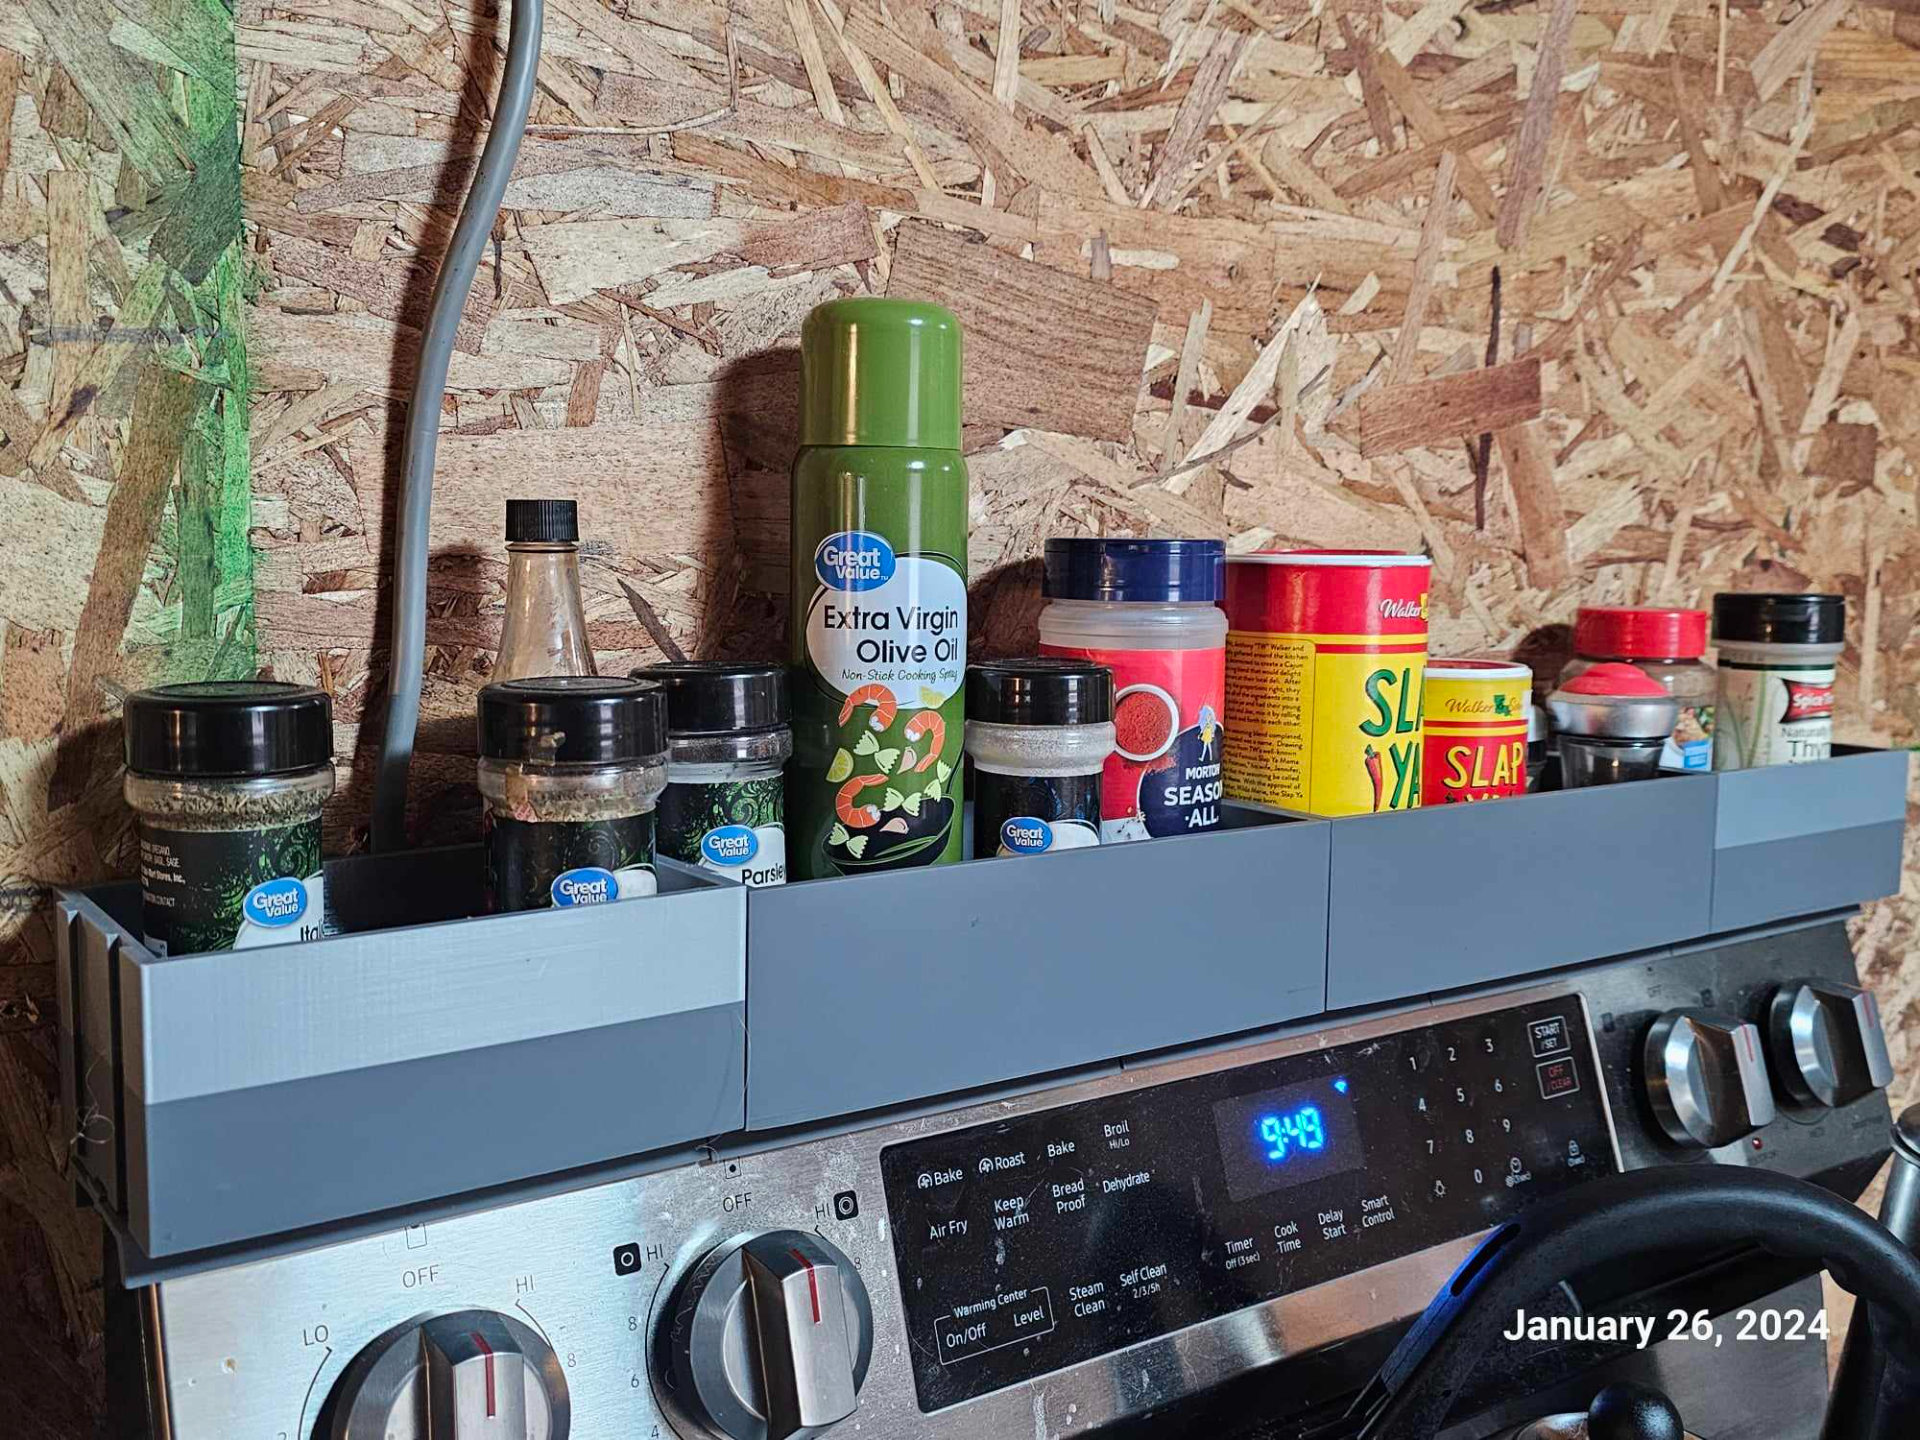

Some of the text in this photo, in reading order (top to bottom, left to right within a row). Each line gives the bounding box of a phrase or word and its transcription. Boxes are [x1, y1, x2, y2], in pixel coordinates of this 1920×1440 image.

[823, 544, 881, 568] Great
[836, 565, 881, 581] Value
[824, 605, 958, 636] Extra Virgin
[856, 638, 958, 663] Olive Oil
[842, 667, 958, 684] Non-Stick Cooking Spray
[1443, 741, 1524, 790] SLAP
[708, 832, 750, 849] Great
[1006, 824, 1044, 839] Great
[718, 845, 750, 858] Value
[1014, 837, 1044, 848] Value
[741, 862, 784, 885] Parsle
[560, 878, 608, 896] Great
[253, 887, 299, 910] Great
[571, 892, 608, 905] Value
[265, 903, 299, 918] Value
[1447, 1047, 1456, 1061] 2
[1484, 1038, 1494, 1052] 3
[1409, 1056, 1417, 1070] 1
[1494, 1079, 1503, 1092] 6
[1456, 1088, 1465, 1102] 5
[1418, 1098, 1427, 1111] 4
[1103, 1120, 1130, 1138] Broil
[1260, 1106, 1324, 1160] 9:49
[1502, 1118, 1511, 1132] 9
[1109, 1137, 1130, 1150] Hi/Lo
[1465, 1129, 1474, 1143] 8
[1047, 1140, 1075, 1157] Bake
[1426, 1140, 1434, 1154] 7
[994, 1152, 1026, 1170] Roast
[933, 1167, 963, 1186] Bake
[1102, 1171, 1150, 1193] Dehydrate
[1474, 1168, 1482, 1183] 0
[1052, 1178, 1085, 1198] Bread
[723, 1192, 752, 1213] OFF
[994, 1196, 1025, 1214] Keep
[1056, 1194, 1086, 1214] Proof
[1361, 1194, 1390, 1212] Smart
[815, 1204, 830, 1220] HI
[1318, 1208, 1344, 1226] Delay
[1362, 1207, 1395, 1227] Control
[930, 1219, 968, 1240] Air Fry
[994, 1212, 1030, 1231] Warm
[1274, 1220, 1299, 1238] Cook
[1322, 1223, 1347, 1240] Start
[646, 1244, 663, 1262] HI
[1224, 1238, 1253, 1254] Timer
[1277, 1238, 1302, 1254] Time
[853, 1257, 863, 1270] 8
[1226, 1257, 1237, 1270] Off
[402, 1264, 439, 1288] OFF
[516, 1274, 535, 1293] HI
[1120, 1263, 1167, 1287] Self Clean
[1069, 1281, 1105, 1300] Steam
[1132, 1282, 1161, 1299] 2/3/5h
[953, 1288, 1028, 1318] Warming Center
[1074, 1299, 1106, 1317] Clean
[628, 1316, 638, 1331] 8
[1013, 1305, 1045, 1327] Level
[303, 1324, 329, 1347] LO
[946, 1322, 987, 1348] On/Off
[566, 1352, 577, 1368] 8
[631, 1374, 640, 1388] 6
